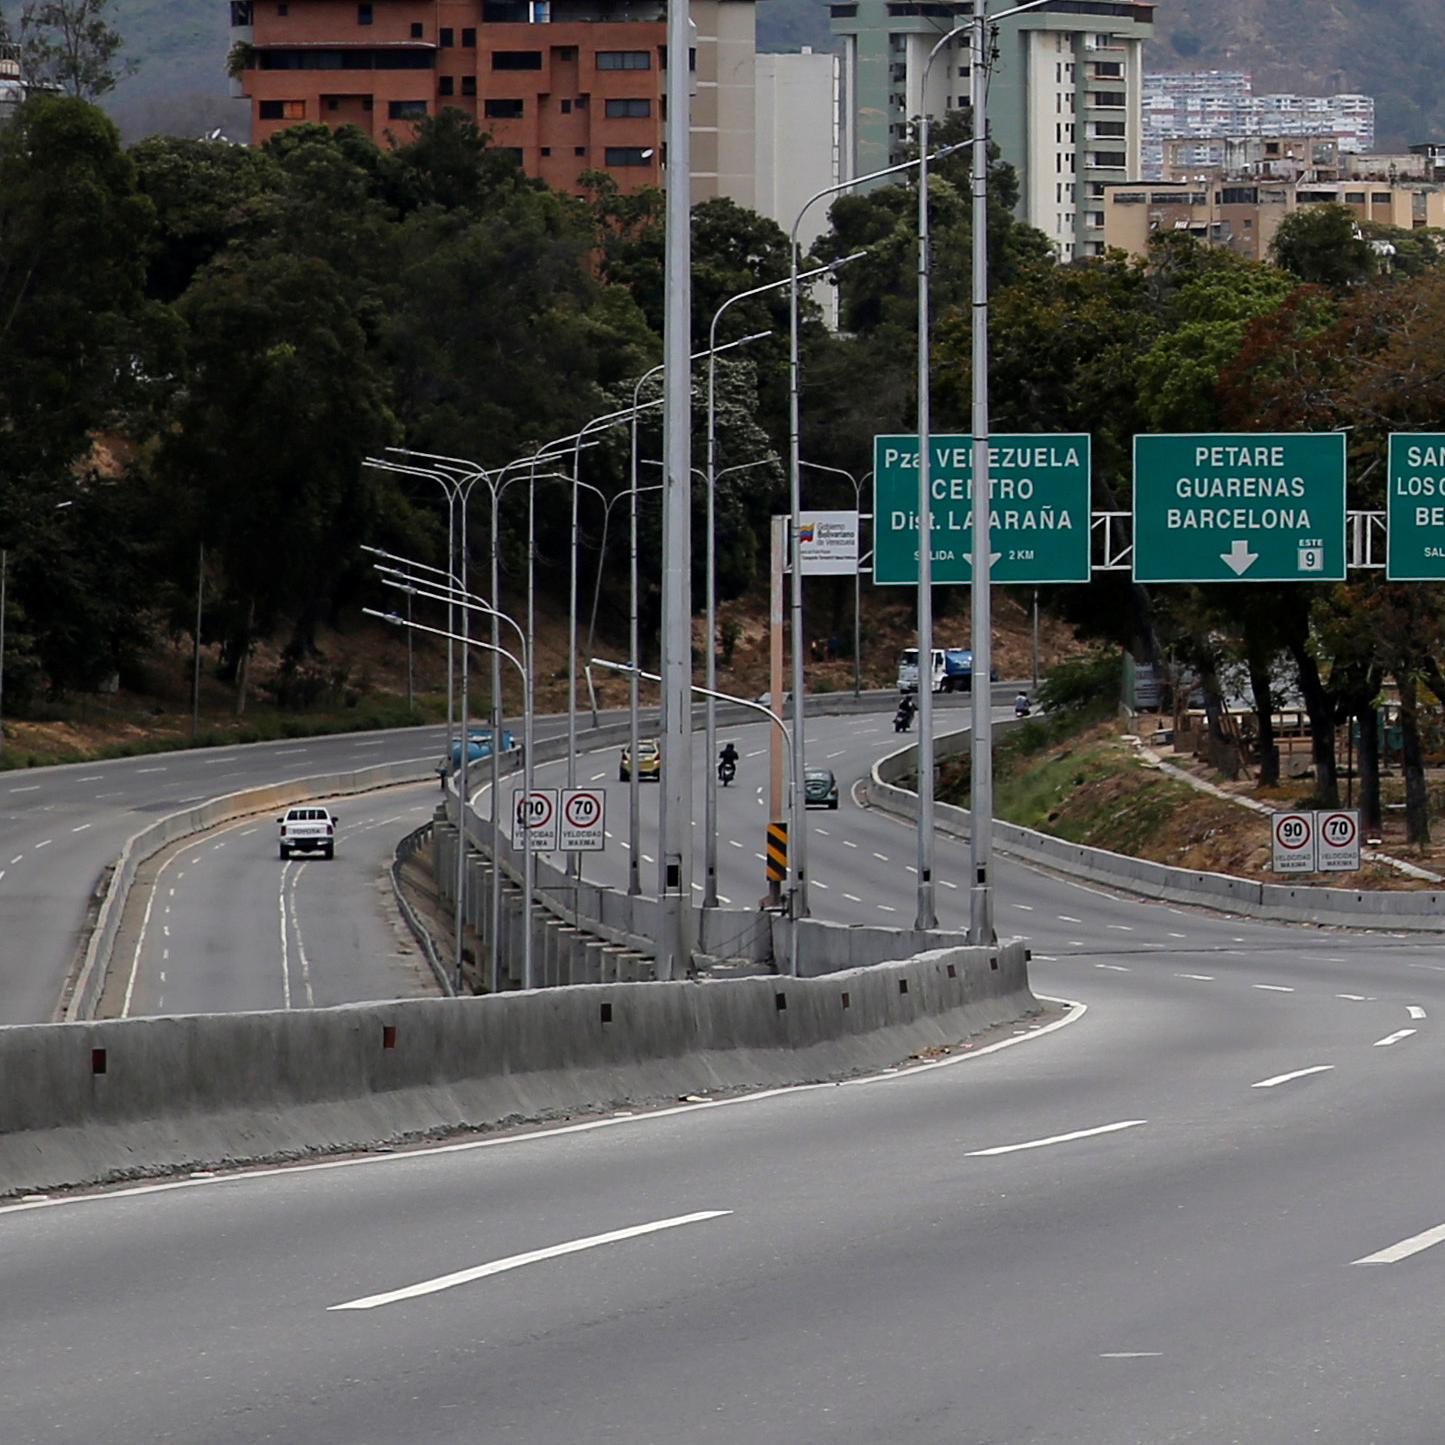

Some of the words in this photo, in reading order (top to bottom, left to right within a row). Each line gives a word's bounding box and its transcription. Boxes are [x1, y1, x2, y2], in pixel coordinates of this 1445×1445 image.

[1195, 446, 1285, 467] PETARE
[1176, 477, 1306, 498] GUARENAS
[1397, 476, 1435, 496] LOS
[988, 505, 1073, 530] ARAÑA
[1167, 508, 1312, 529] BARCELONA
[1299, 538, 1324, 547] ESTE
[913, 550, 955, 561] SLIDA
[1008, 550, 1016, 560] 2
[1305, 551, 1316, 568] 9
[574, 801, 593, 815] 70
[1283, 823, 1302, 837] 90
[1330, 821, 1348, 835] 70
